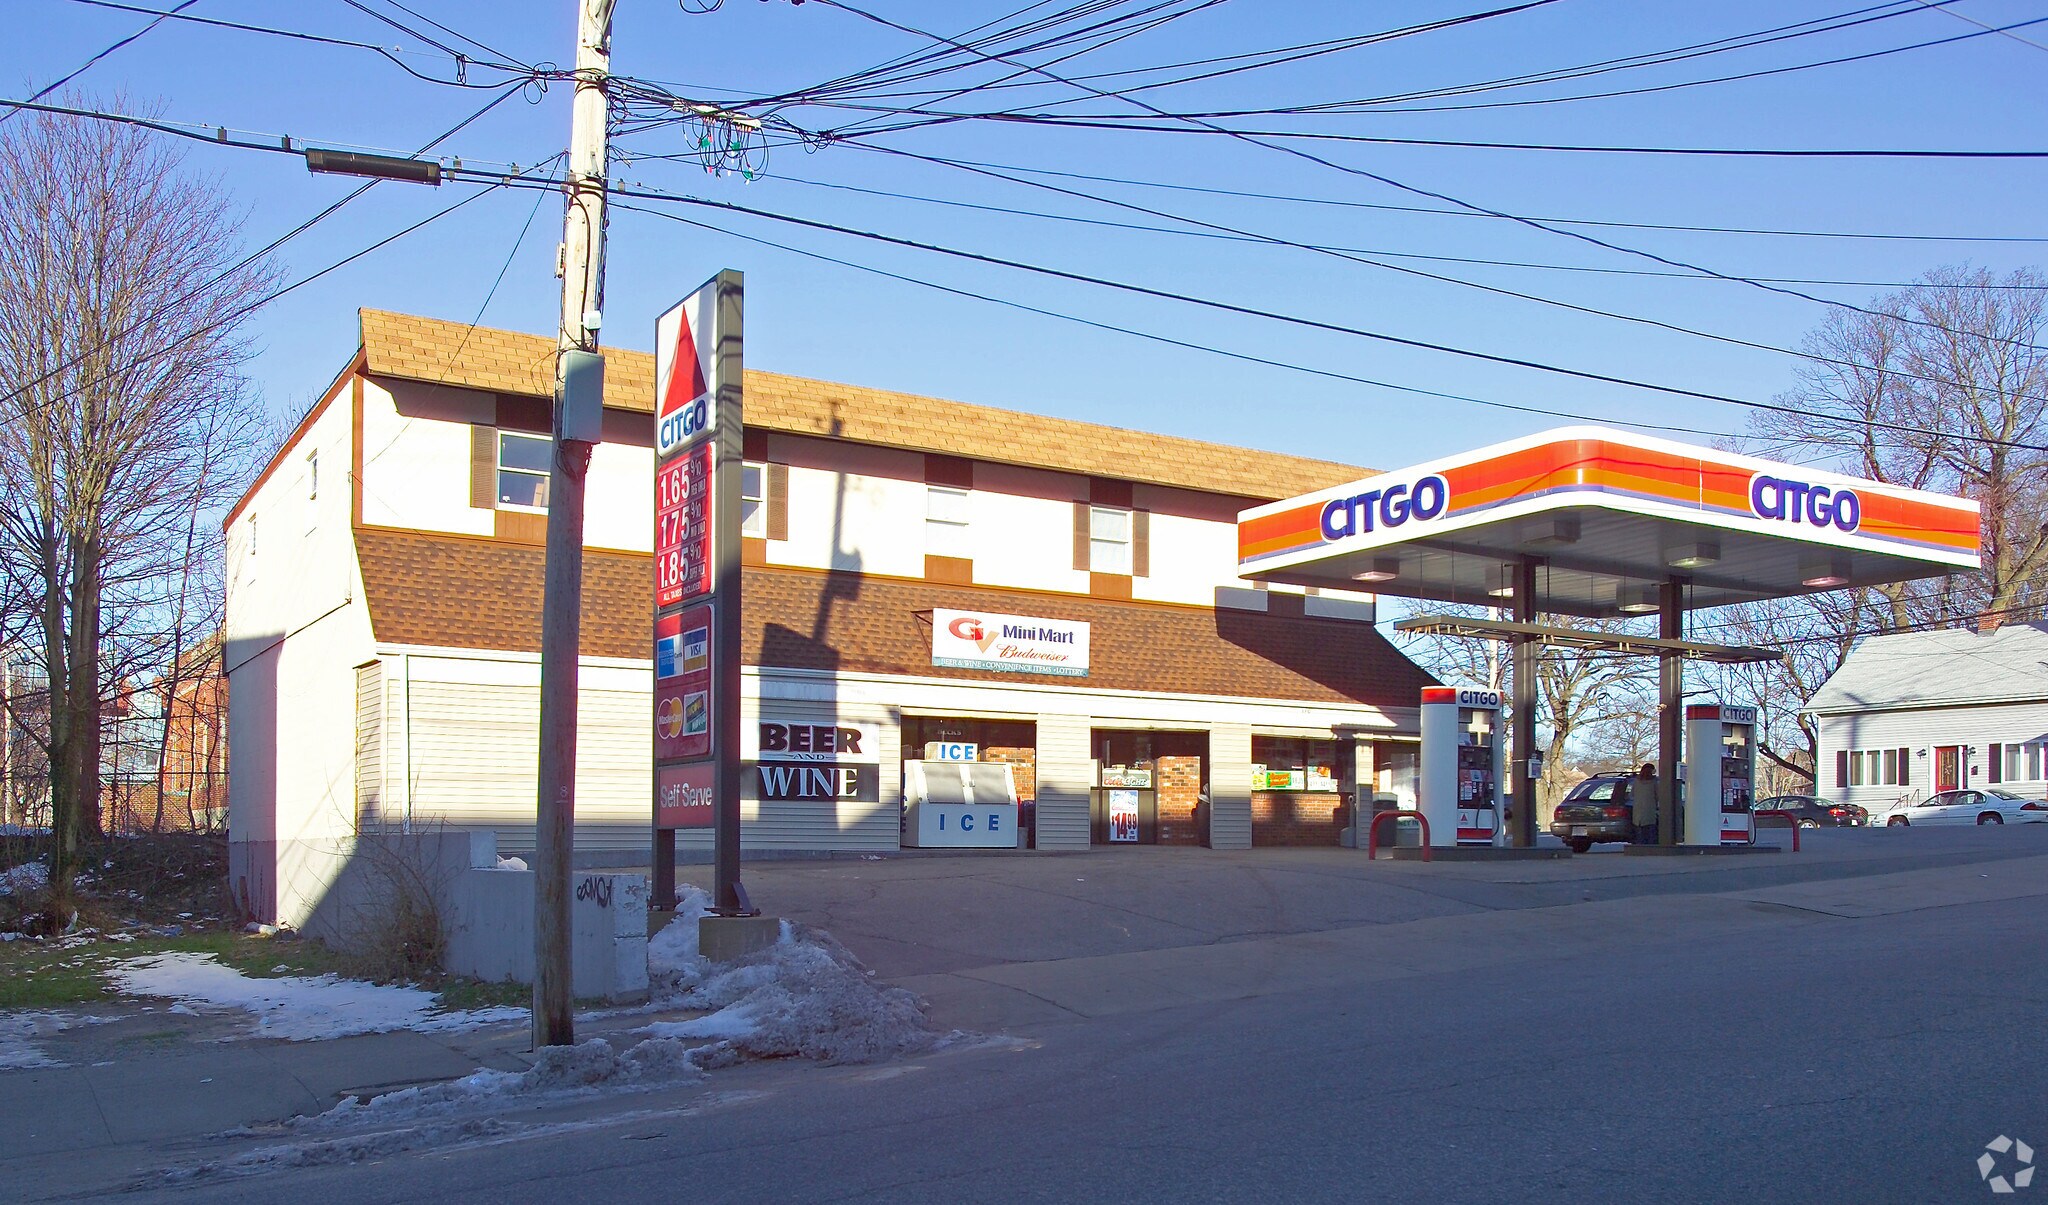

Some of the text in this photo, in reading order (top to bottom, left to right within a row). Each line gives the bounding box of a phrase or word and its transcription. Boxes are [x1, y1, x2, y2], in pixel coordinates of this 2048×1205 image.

[660, 400, 706, 448] CITGO
[660, 463, 690, 508] 1.65
[1321, 476, 1445, 540] CITGO
[1752, 475, 1860, 532] CITGO
[659, 546, 689, 589] 1.85
[1003, 624, 1036, 641] Mini
[1039, 627, 1074, 645] Mart
[690, 643, 702, 657] VISA
[996, 643, 1069, 662] Budweiser
[963, 660, 982, 668] WINE
[986, 661, 1032, 671] CONVENIENCE
[1032, 665, 1052, 673] ITEMS
[1056, 667, 1084, 676] LOTTERY
[1460, 690, 1498, 706] CITGO
[1723, 707, 1753, 721] CITGO
[758, 722, 862, 754] BEER
[941, 744, 974, 760] ICE
[757, 765, 858, 797] WINE
[660, 782, 713, 808] Self Serve
[940, 814, 999, 831] ICE
